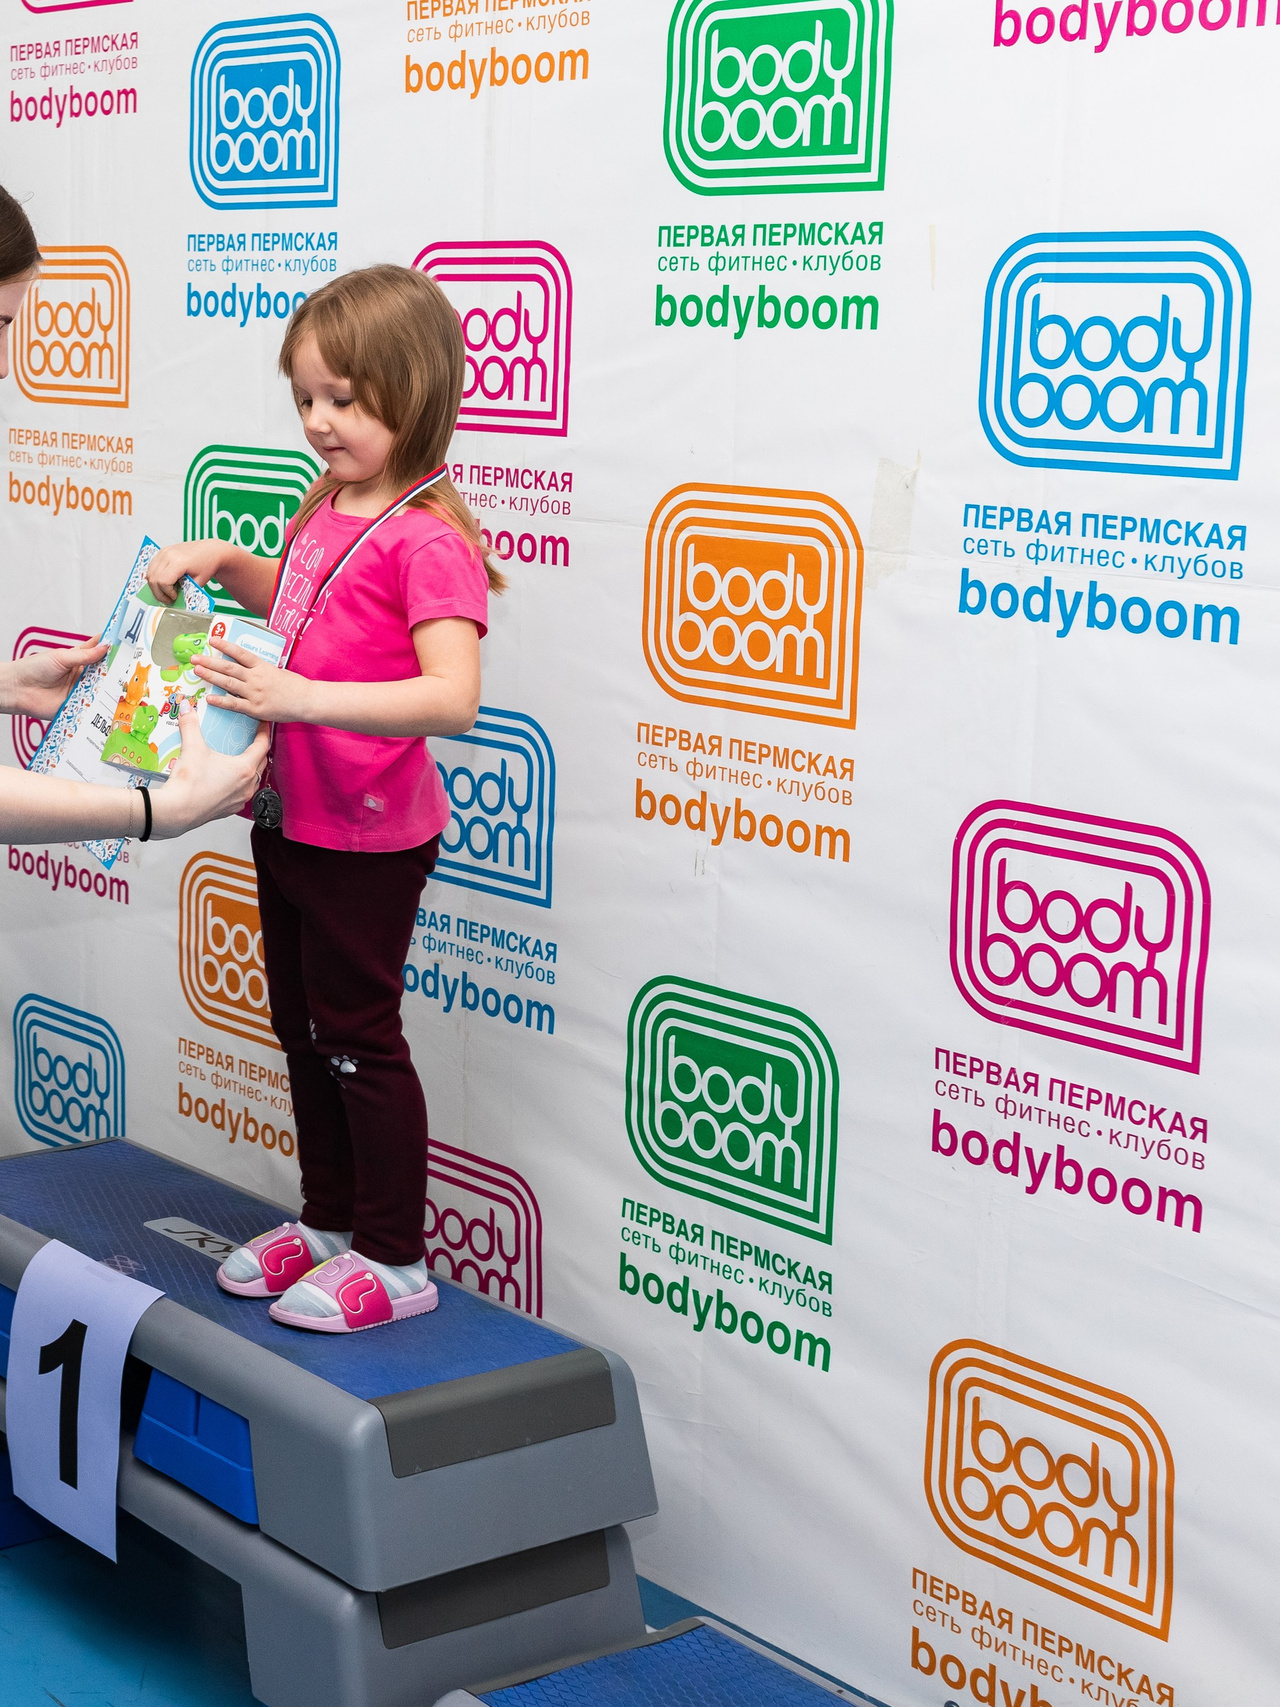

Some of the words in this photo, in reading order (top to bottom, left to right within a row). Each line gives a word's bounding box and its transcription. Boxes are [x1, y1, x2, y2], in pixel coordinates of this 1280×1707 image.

[406, 0, 479, 21] ПЕРВАЯ
[407, 26, 442, 44] сеть
[10, 40, 61, 61] ПЕРВАЯ
[65, 31, 139, 55] ПЕРМСКАЯ
[11, 67, 35, 80] сеть
[404, 46, 589, 100] bodyboom
[710, 20, 856, 95] body
[10, 85, 137, 128] bodyboom
[221, 69, 319, 131] body
[695, 94, 853, 152] boom
[210, 128, 315, 172] boom
[187, 233, 247, 253] ПЕРВАЯ
[251, 231, 338, 252] ПЕРМСКАЯ
[657, 255, 700, 272] сеть
[658, 223, 746, 248] ПЕРВАЯ
[752, 221, 884, 247] ПЕРМСКАЯ
[187, 258, 217, 272] сеть
[35, 287, 114, 341] body
[454, 290, 549, 354] ody
[654, 283, 879, 340] bodyboom
[1030, 293, 1214, 376] body
[27, 339, 114, 379] boom
[462, 355, 548, 402] oom
[1010, 372, 1207, 436] boom
[8, 427, 58, 448] ПЕРВАЯ
[61, 432, 134, 454] ПЕРМСКАЯ
[8, 450, 34, 464] сеть
[8, 470, 133, 517] bodyboom
[469, 464, 573, 493] ПЕРМСКАЯ
[212, 494, 290, 556] bod
[962, 503, 1072, 537] ПЕРВАЯ
[1081, 512, 1247, 552] ПЕРМСКАЯ
[962, 536, 1016, 558] сеть
[686, 542, 828, 622] body
[958, 567, 1240, 646] bodyboom
[674, 612, 824, 679] boom
[637, 721, 723, 758] ПЕРВАЯ
[729, 737, 855, 782] ПЕРМСКАЯ
[637, 750, 679, 773] сеть
[436, 758, 534, 822] ody
[440, 810, 531, 872] oom
[635, 777, 851, 863] bodyboom
[8, 845, 129, 904] bodyboom
[997, 858, 1176, 960] body
[456, 917, 558, 964] ПЕРМСКАЯ
[199, 953, 271, 1012] boo
[402, 962, 556, 1036] odyboom
[980, 932, 1168, 1026] boom
[33, 1031, 111, 1104] body
[178, 1037, 234, 1072] ПЕРВАЯ
[178, 1061, 206, 1081] сеть
[669, 1035, 804, 1130] body
[28, 1080, 111, 1141] boom
[178, 1082, 298, 1159] bodyboo
[935, 1079, 986, 1108] сеть
[935, 1047, 1040, 1097] ПЕРВАЯ
[1048, 1077, 1208, 1143] ПЕРМСКАЯ
[654, 1100, 802, 1190] boom
[931, 1108, 1203, 1233] bodyboom
[620, 1227, 662, 1254] сеть
[621, 1198, 704, 1246] ПЕРВАЯ
[711, 1230, 833, 1295] ПЕРМСКАЯ
[619, 1252, 831, 1372] bodyboom
[39, 1318, 88, 1490] 1
[971, 1396, 1140, 1530] body
[954, 1466, 1140, 1589] boom
[912, 1599, 962, 1635] сеть
[912, 1567, 1013, 1635] ПЕРВАЯ
[1022, 1618, 1174, 1707] ПЕРМСКАЯ
